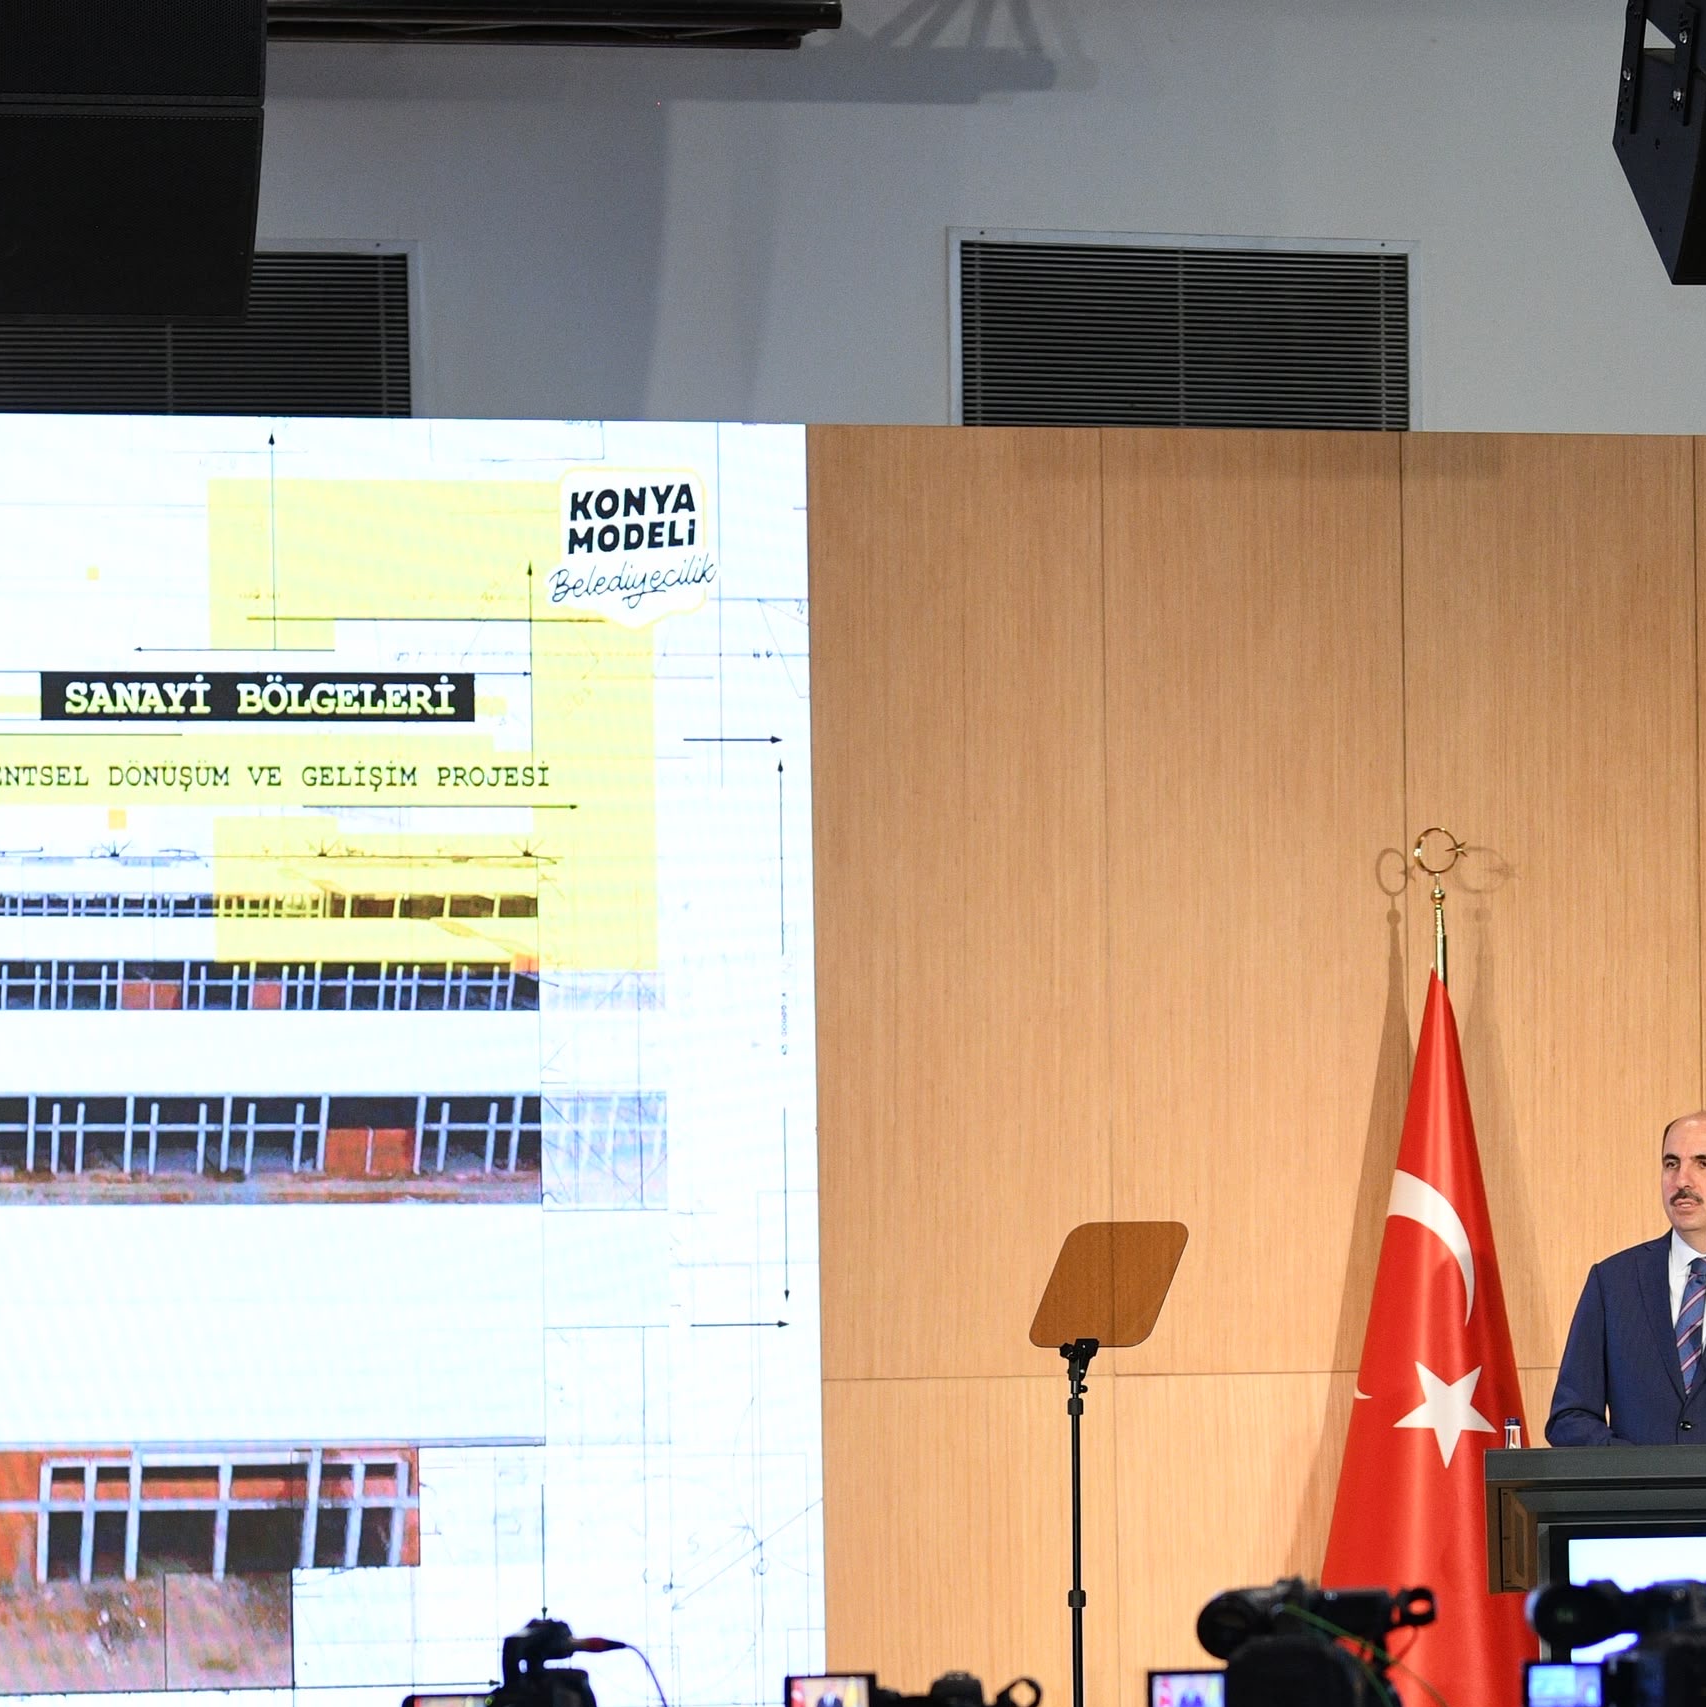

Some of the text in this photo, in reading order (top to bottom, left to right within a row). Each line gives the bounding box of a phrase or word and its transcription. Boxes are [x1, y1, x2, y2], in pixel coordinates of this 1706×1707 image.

[570, 484, 695, 521] KONYA
[549, 553, 717, 609] Belediyecilik
[65, 674, 456, 715] SANAYİ BÖLGELERİ
[108, 760, 230, 791] DÖNÜŞÜM
[247, 766, 282, 787] VE
[302, 761, 418, 792] GELİŞİM
[437, 761, 550, 787] PROJESİ
